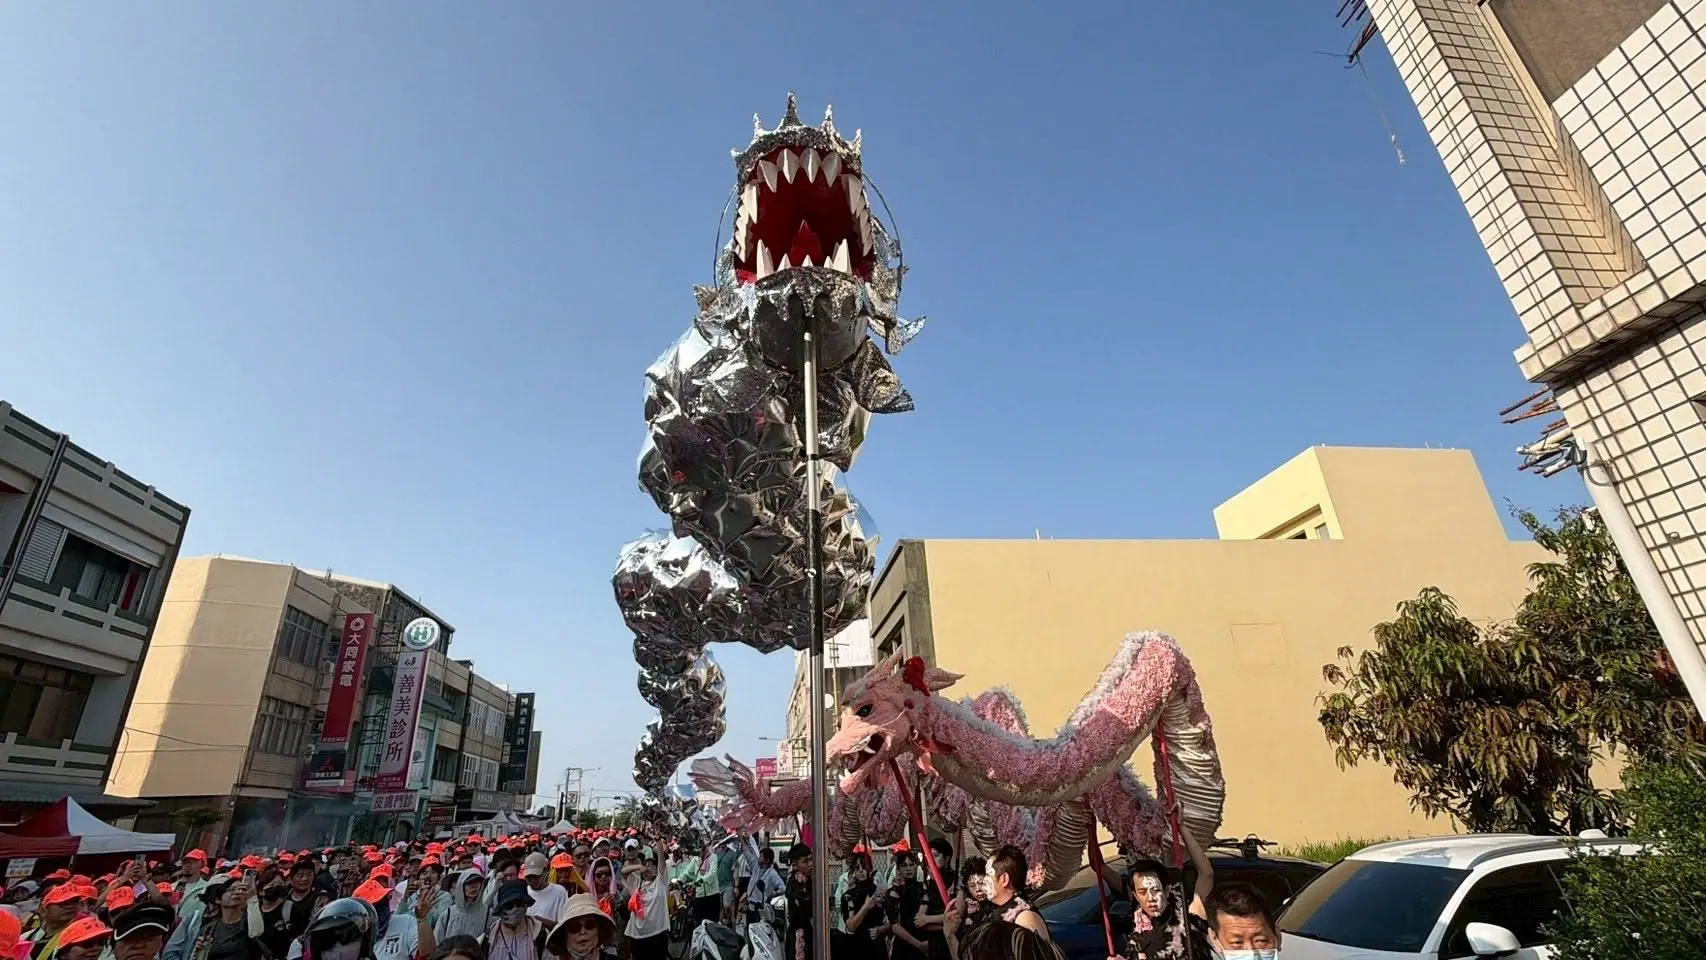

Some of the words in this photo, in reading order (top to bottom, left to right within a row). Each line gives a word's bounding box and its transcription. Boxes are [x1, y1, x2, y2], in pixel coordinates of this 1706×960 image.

[339, 632, 361, 688] 大同家電
[384, 674, 415, 763] 善美診所
[374, 794, 413, 810] 皮膚門診
